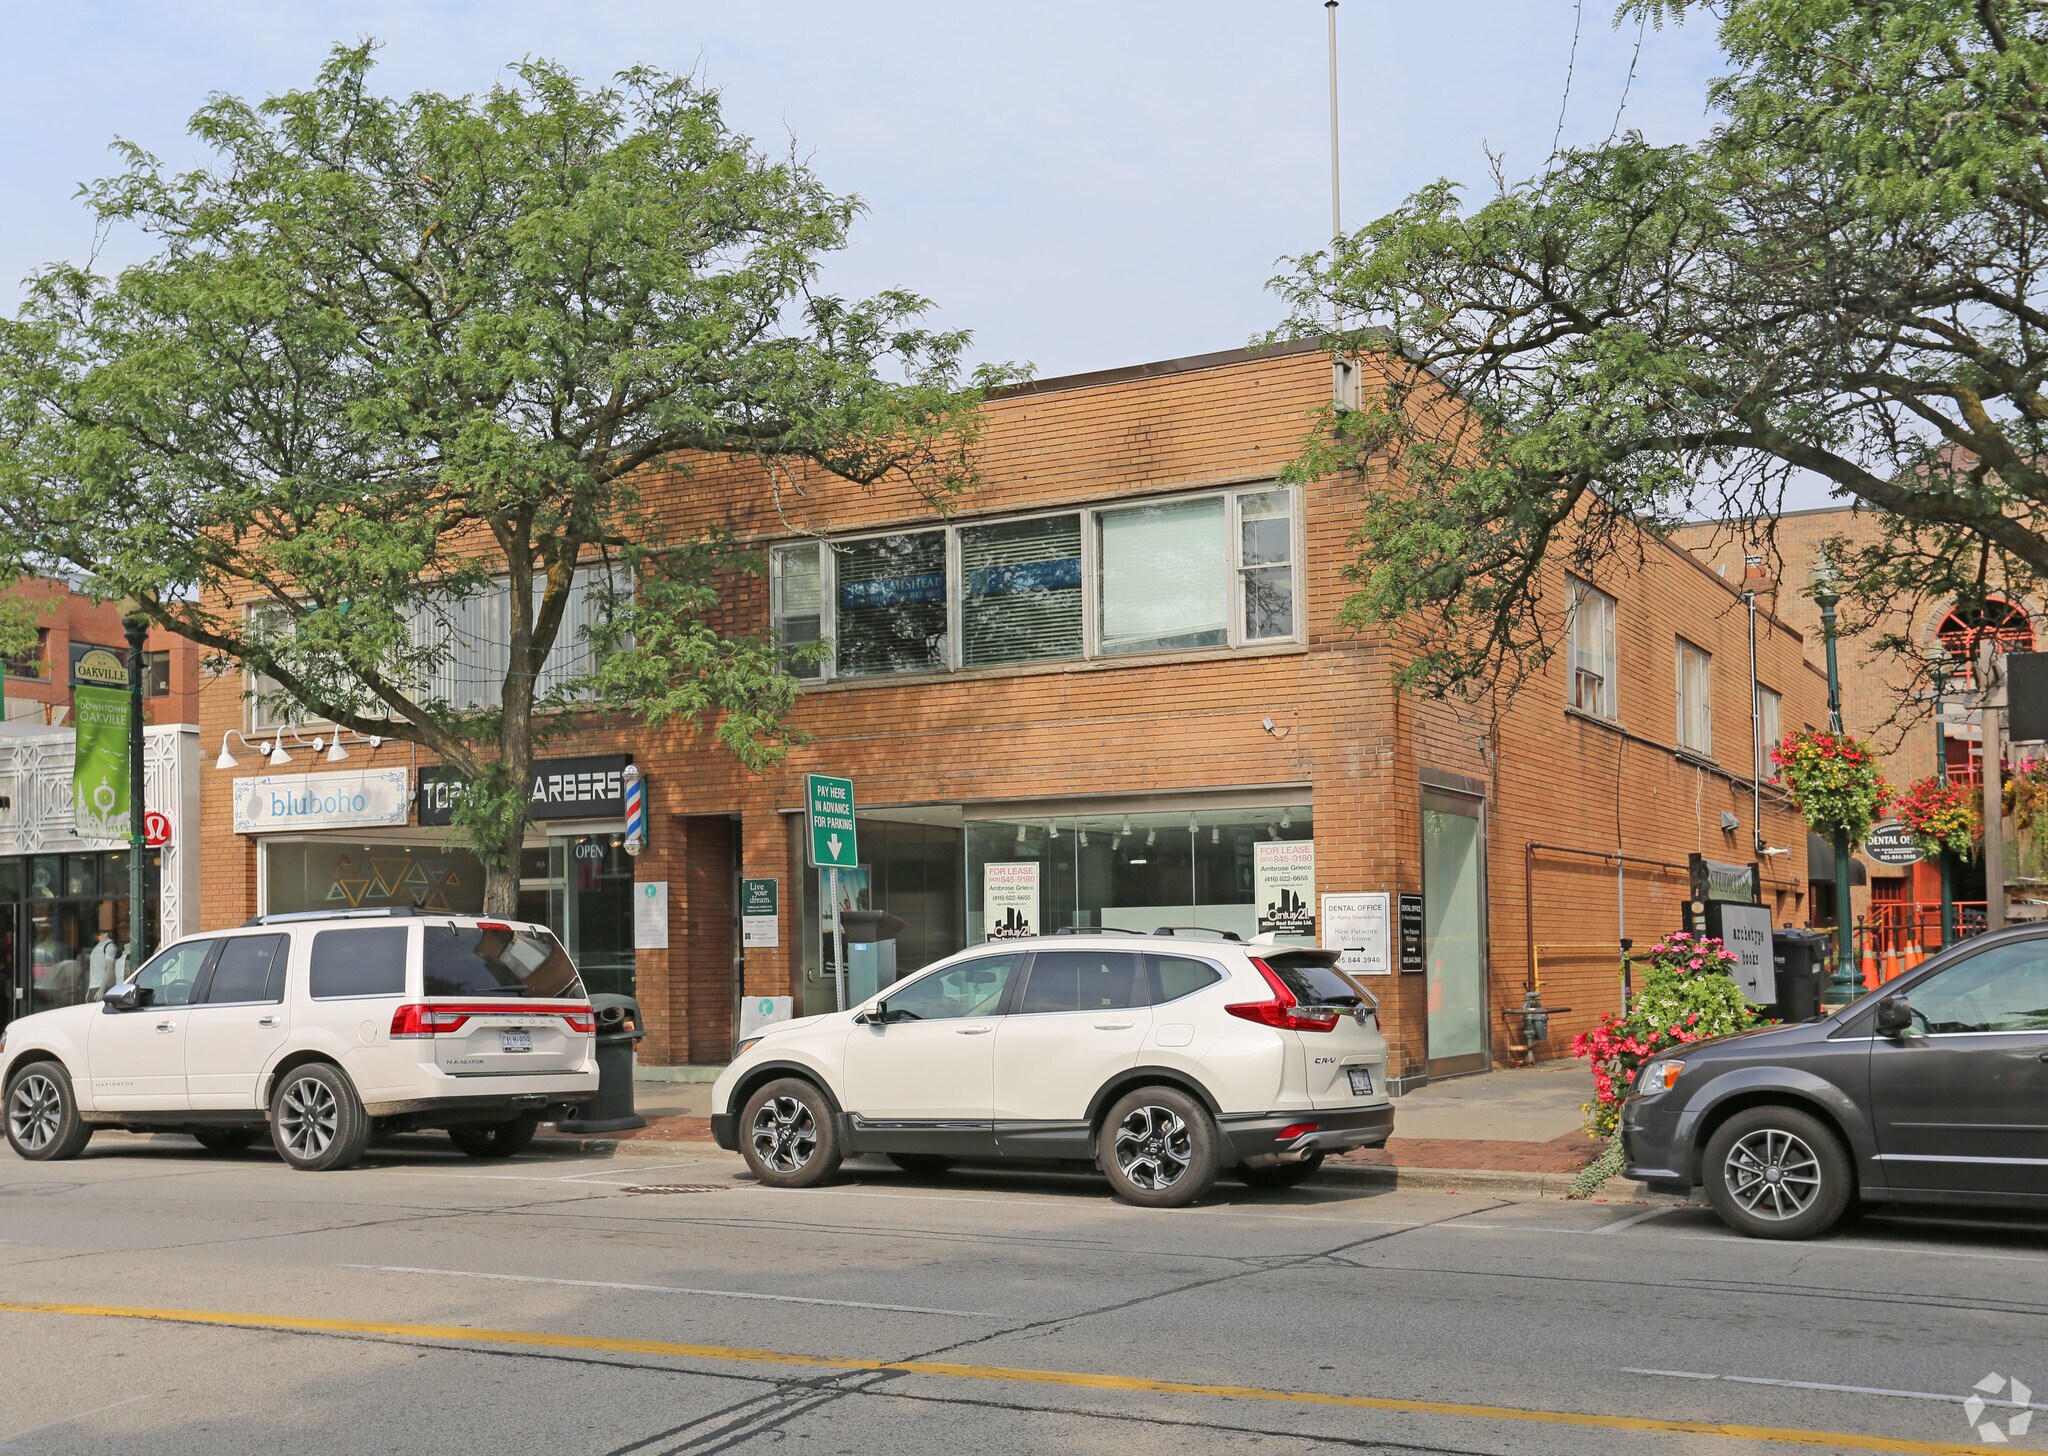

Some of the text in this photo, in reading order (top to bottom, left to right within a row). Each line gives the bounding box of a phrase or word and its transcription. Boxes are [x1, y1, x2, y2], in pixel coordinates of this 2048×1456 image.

[78, 665, 126, 681] OAKVILLE
[81, 702, 127, 714] DOWNTOWN
[80, 711, 127, 725] OAKVILLE
[527, 771, 621, 802] ARBERS
[817, 785, 846, 799] PAY HERE
[271, 788, 365, 817] bluboho
[815, 800, 850, 815] IN ADVANCE
[814, 816, 853, 831] FOR PARKING
[1868, 835, 1899, 846] DENTAL
[575, 844, 604, 858] OPEN
[1260, 846, 1311, 855] FOR LEASE
[1008, 867, 1034, 875] LEASE
[750, 882, 765, 891] Live
[749, 896, 772, 904] dream.
[1733, 926, 1764, 945] archetype
[1742, 950, 1759, 966] books
